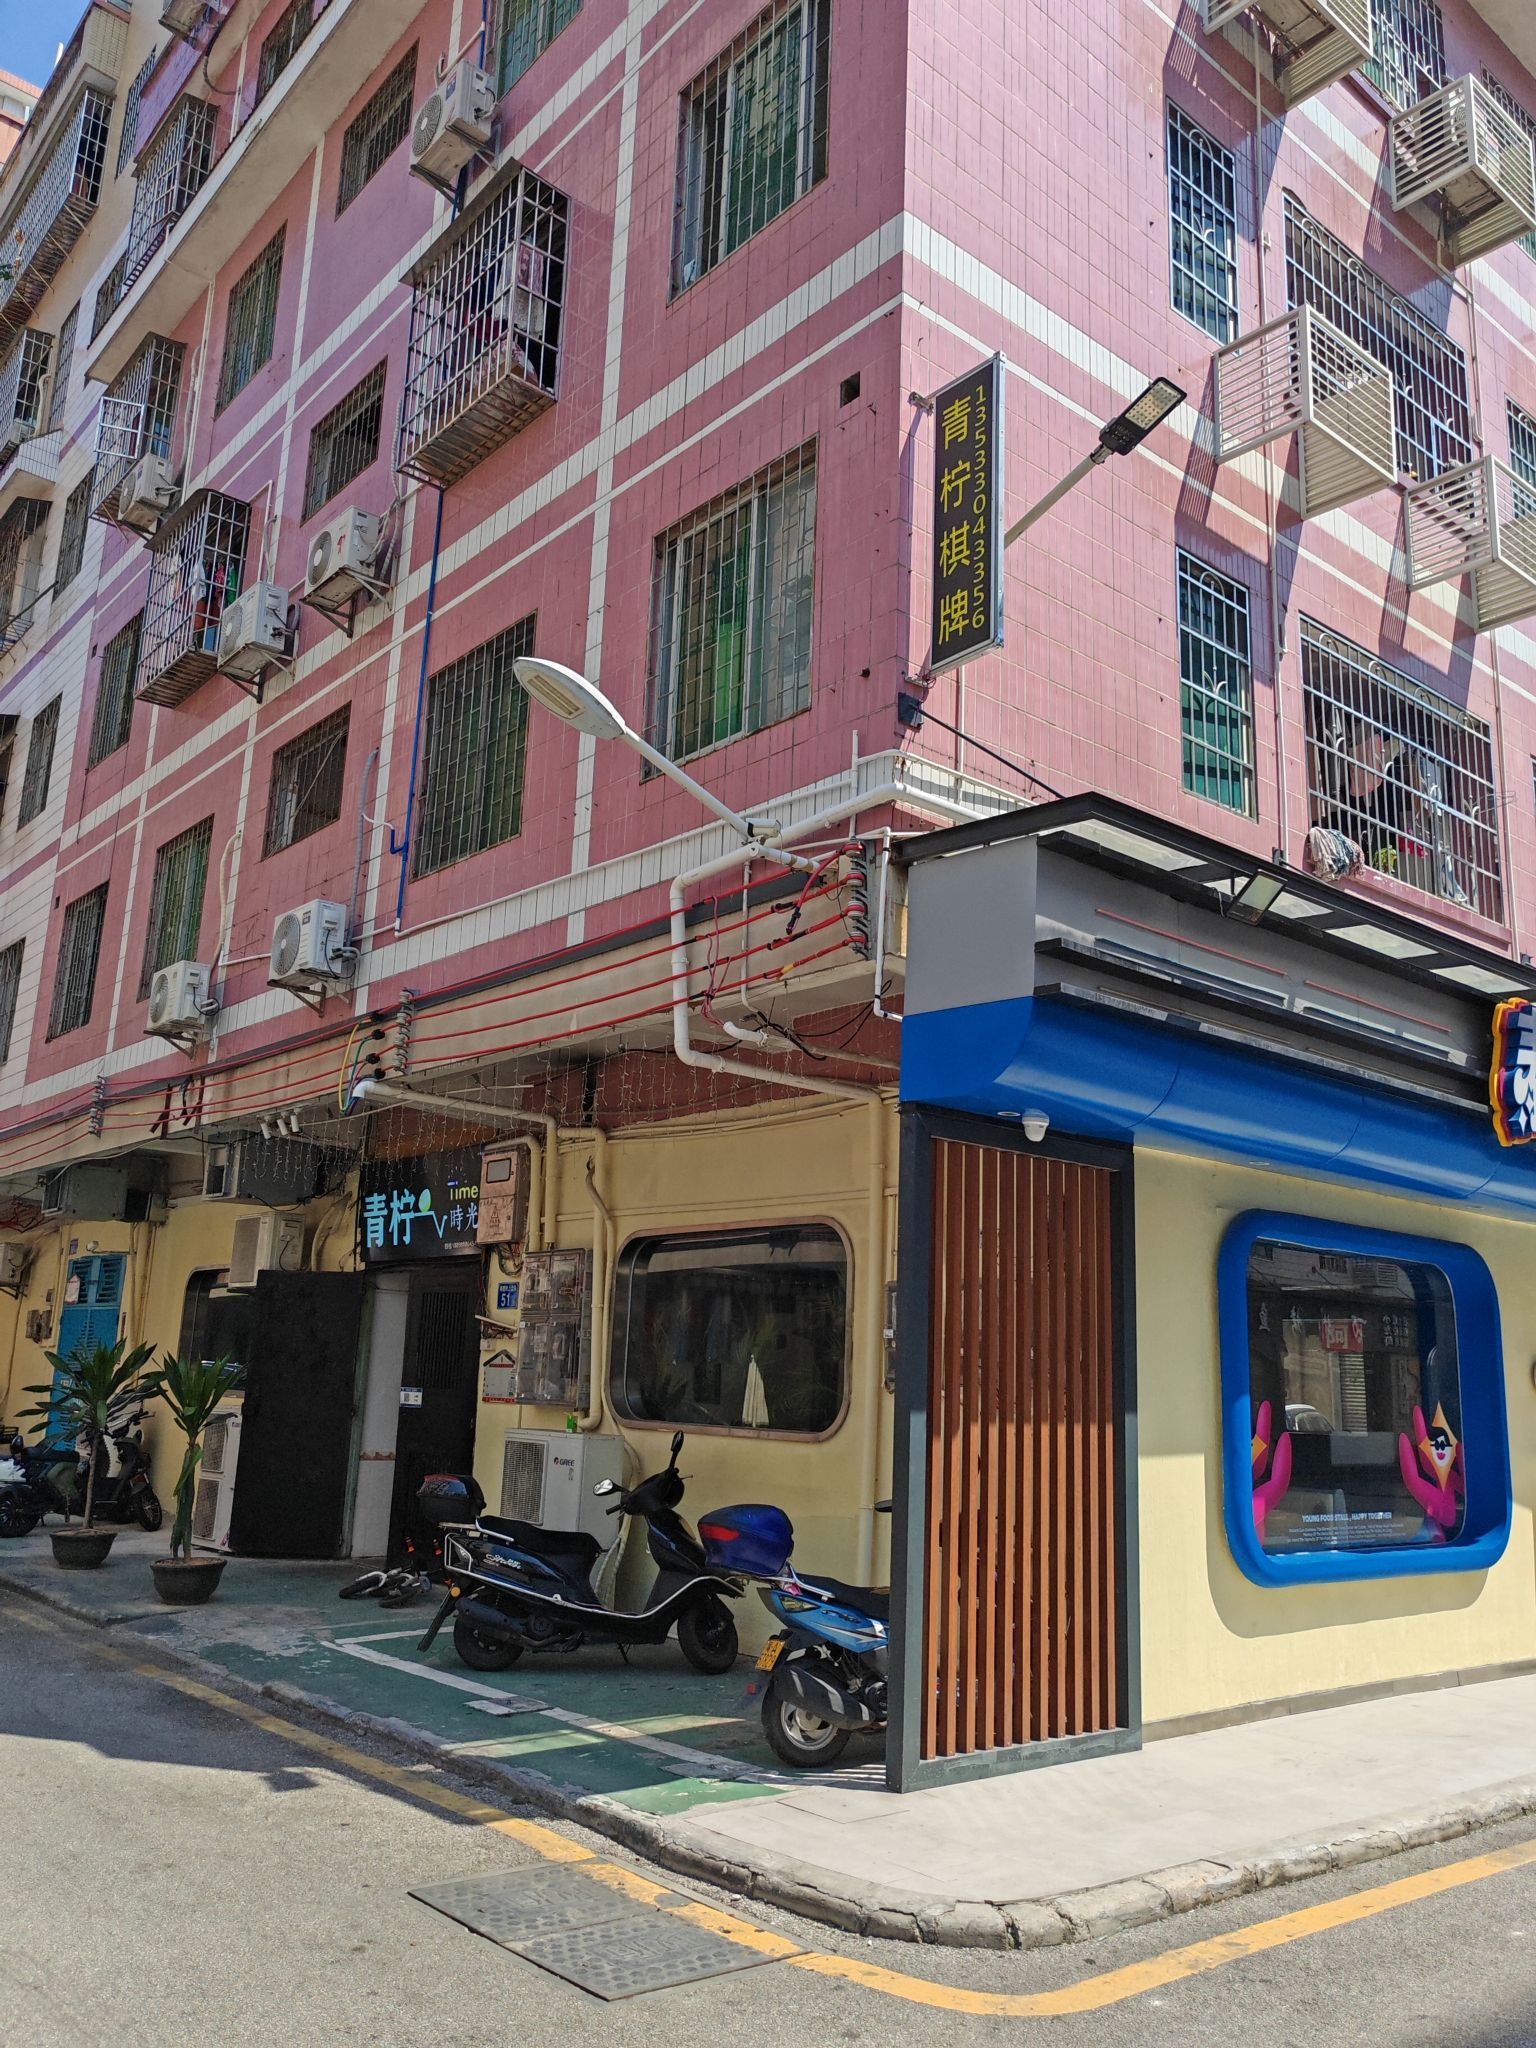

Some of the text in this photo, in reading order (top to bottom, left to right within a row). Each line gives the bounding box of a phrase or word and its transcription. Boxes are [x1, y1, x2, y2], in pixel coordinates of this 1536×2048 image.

[938, 394, 971, 645] 青柠棋牌
[972, 384, 986, 630] 13533043356
[363, 1187, 416, 1248] 青柠
[450, 1201, 479, 1232] 時光
[1302, 1514, 1319, 1522] YOUNG
[1352, 1512, 1367, 1520] HAPPY
[1368, 1512, 1392, 1520] TOGETHER
